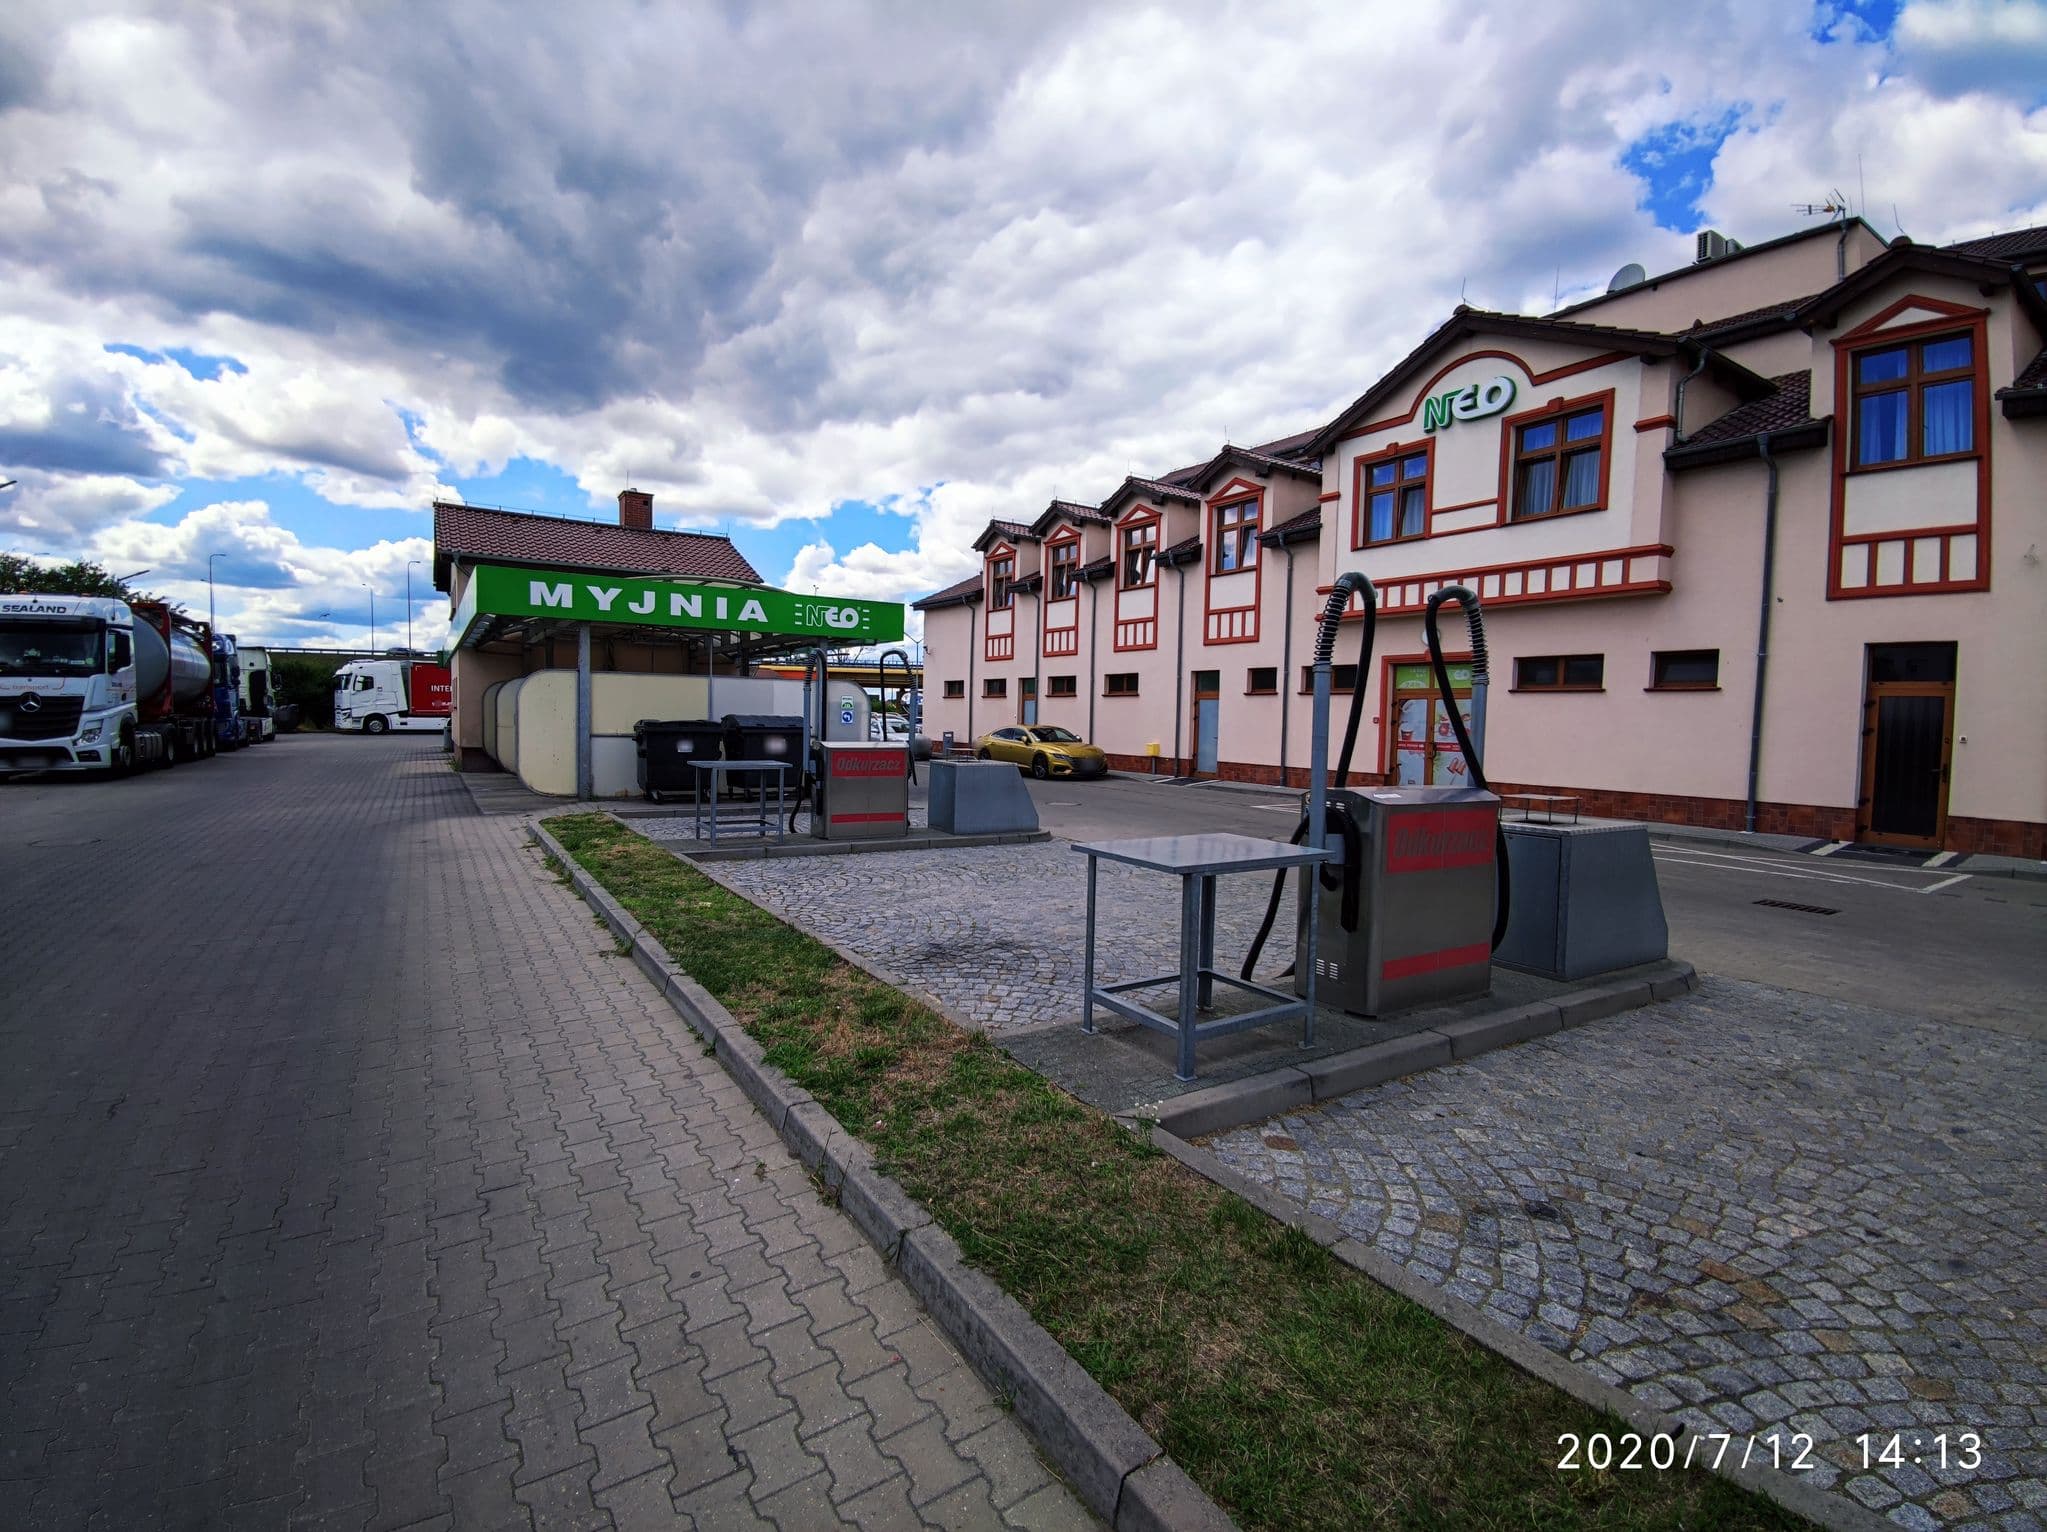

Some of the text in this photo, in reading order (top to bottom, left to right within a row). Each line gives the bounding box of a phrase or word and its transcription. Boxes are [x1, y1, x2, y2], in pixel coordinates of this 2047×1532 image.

[1424, 376, 1517, 433] NEO
[2, 604, 67, 614] SEALAND
[529, 581, 859, 629] MYJNIA NEO
